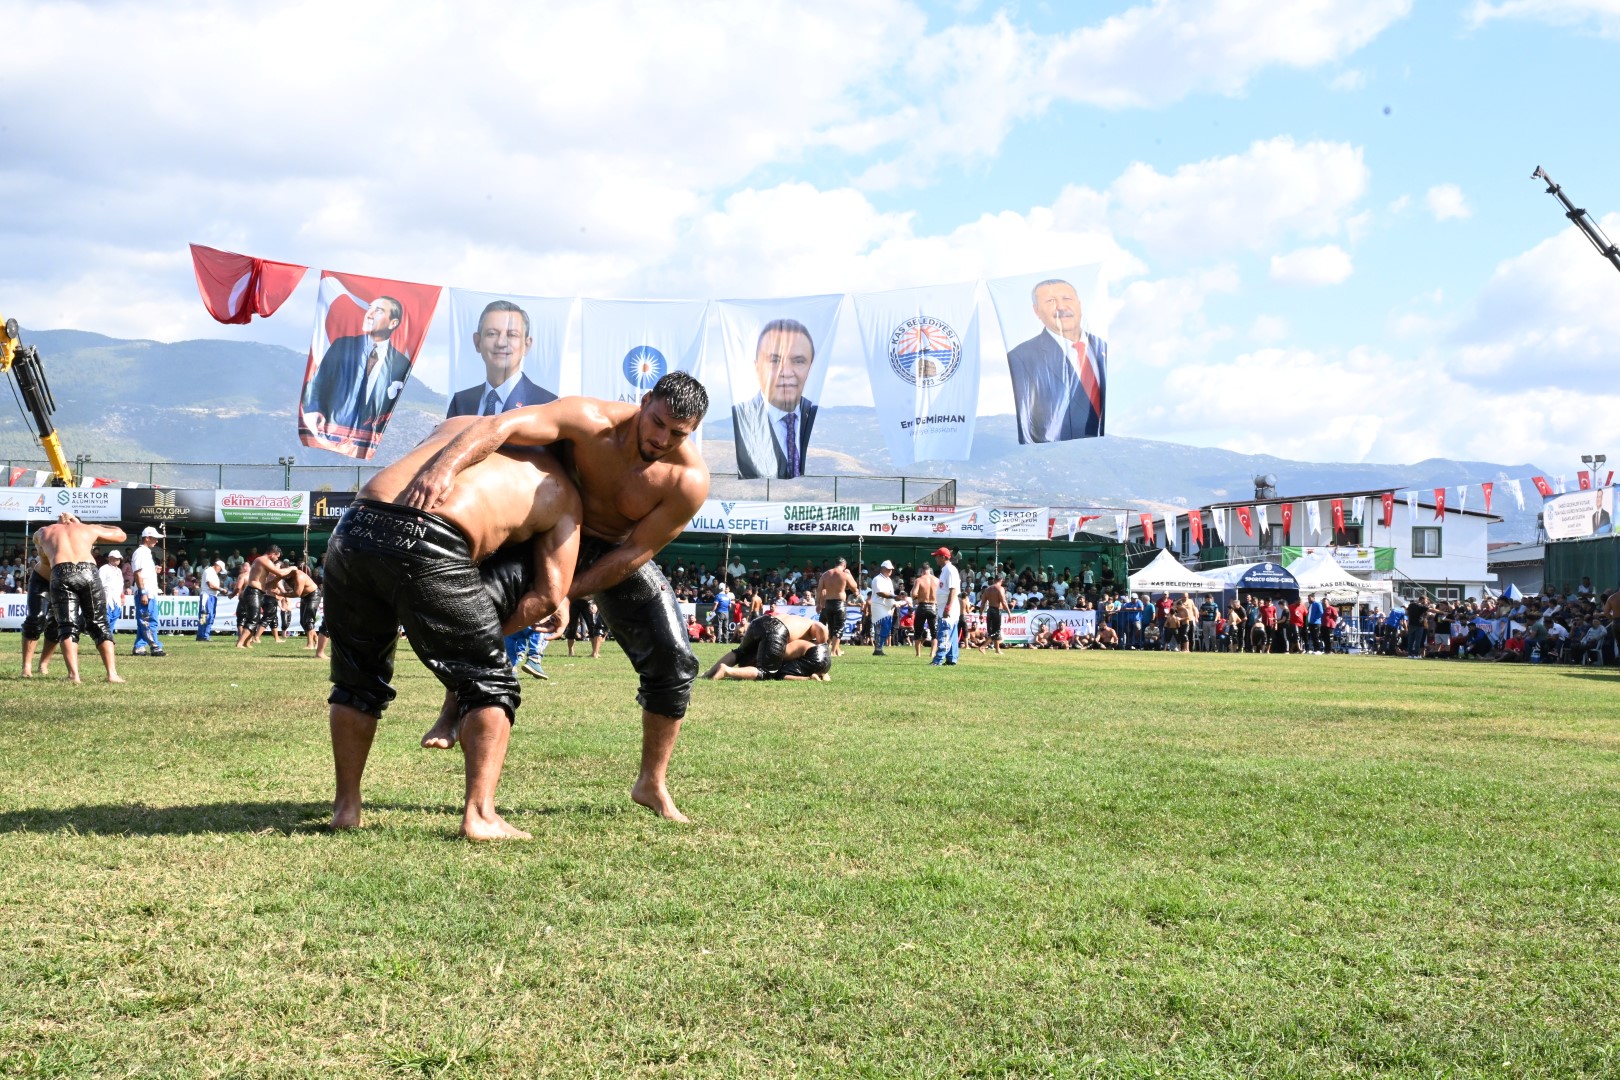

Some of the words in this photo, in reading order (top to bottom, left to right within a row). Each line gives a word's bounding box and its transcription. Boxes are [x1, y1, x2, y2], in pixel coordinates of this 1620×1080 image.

[915, 414, 966, 425] DEMİRHAN
[72, 491, 109, 499] SEKTOR
[315, 496, 350, 517] ALDENİ
[784, 505, 823, 521] SARICA
[827, 506, 860, 521] TARIM
[892, 512, 934, 523] beşkaza
[692, 516, 725, 530] VİLLA
[727, 517, 769, 531] SEPETİ
[787, 523, 817, 531] RECEP
[819, 523, 855, 532] SARICA
[157, 598, 175, 616] KDİ
[178, 600, 199, 616] TAR
[159, 617, 179, 628] VELİ
[181, 619, 199, 628] EKD
